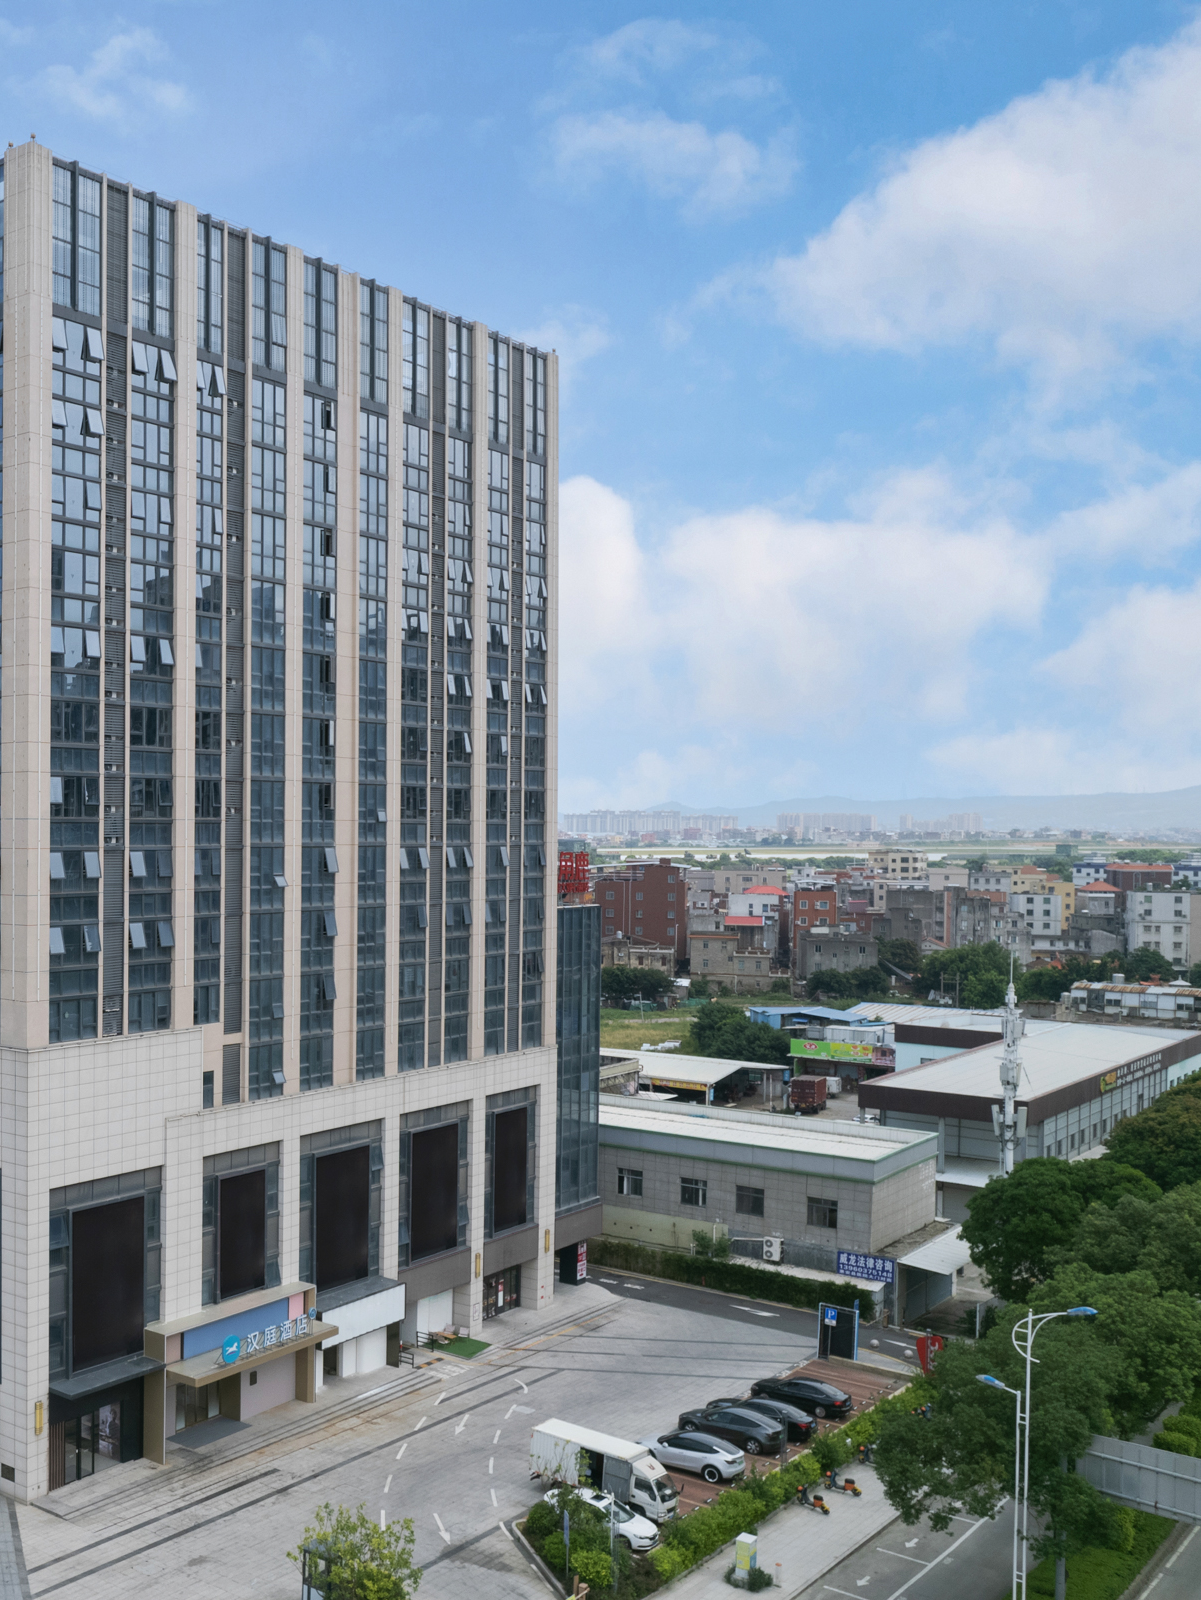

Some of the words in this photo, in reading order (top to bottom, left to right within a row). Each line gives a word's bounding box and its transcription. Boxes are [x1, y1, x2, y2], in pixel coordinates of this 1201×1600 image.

[839, 1253, 893, 1273] 威龙法律咨询
[827, 1309, 835, 1319] P
[247, 1313, 307, 1353] 汉庭酒店
